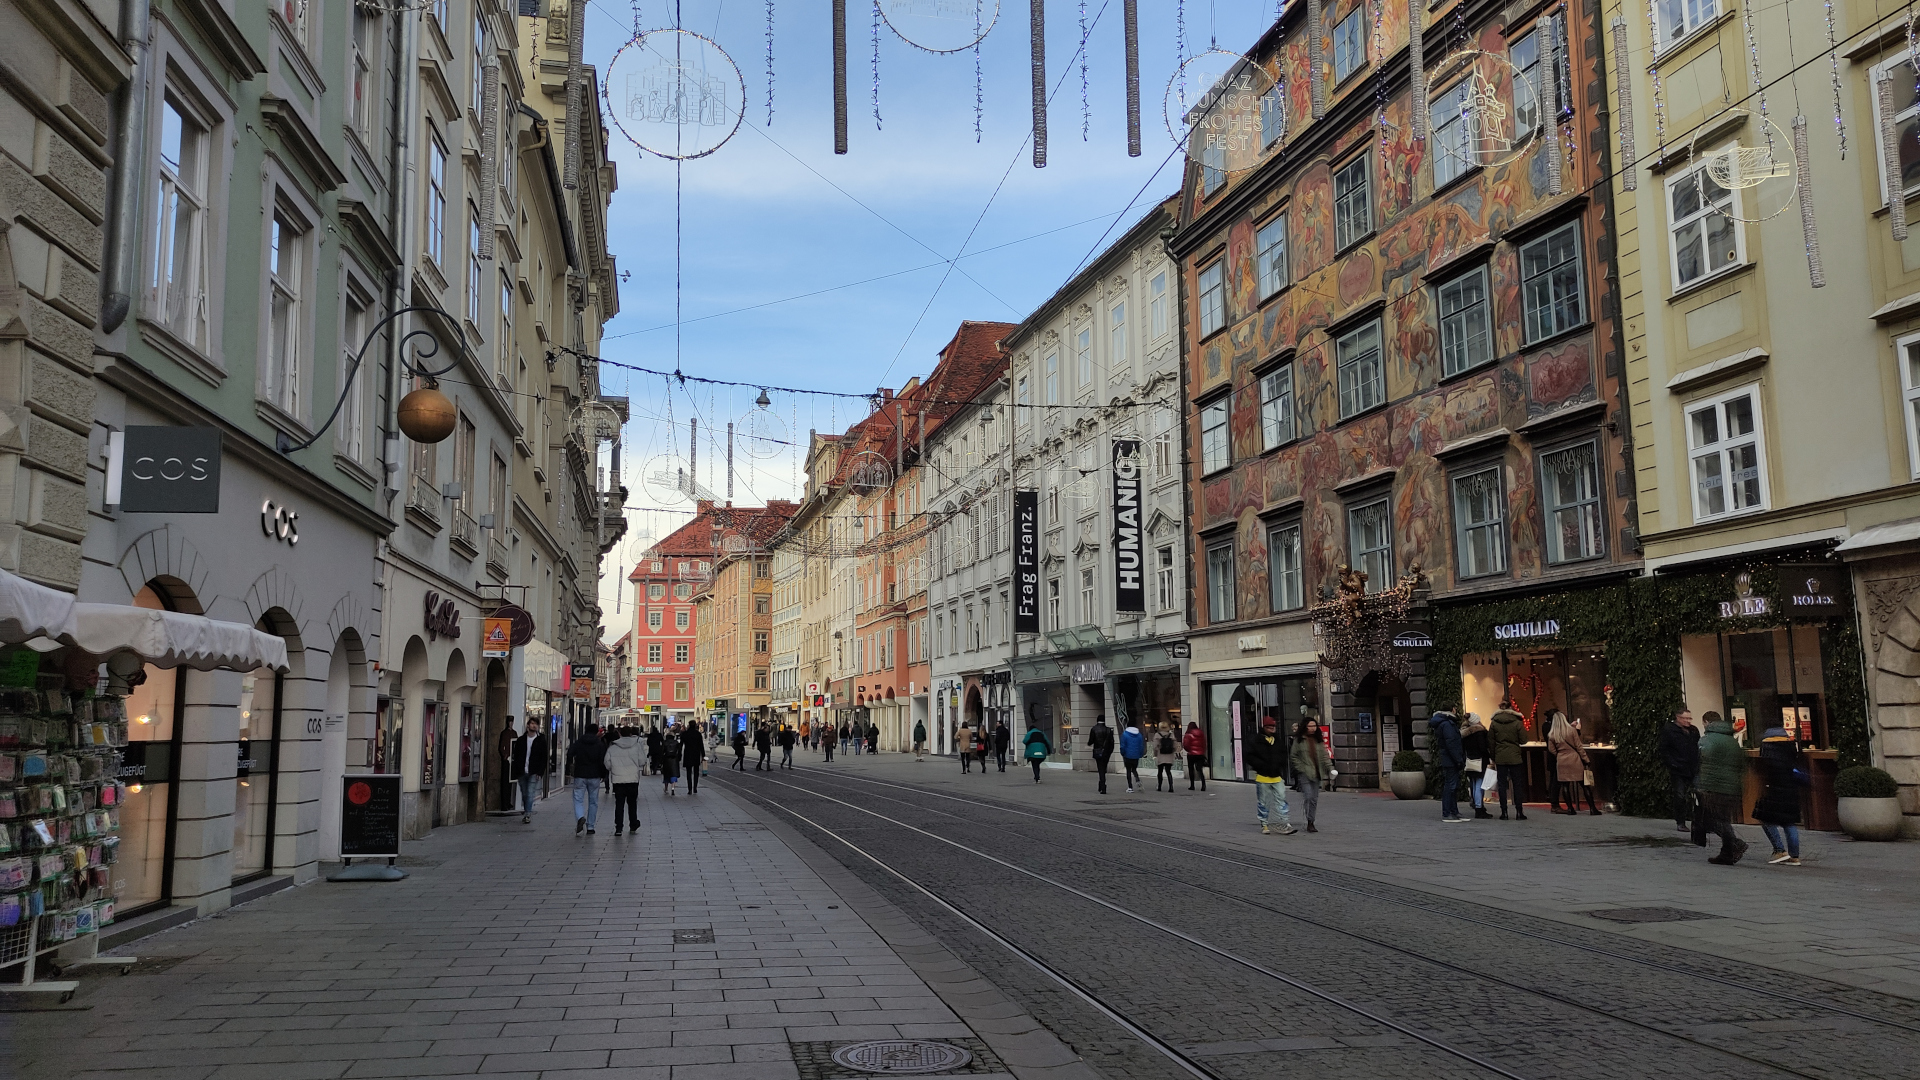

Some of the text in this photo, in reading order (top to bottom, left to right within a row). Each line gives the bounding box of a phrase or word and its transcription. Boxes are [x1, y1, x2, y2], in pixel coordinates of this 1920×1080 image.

[1198, 72, 1252, 91] GRAZ
[1188, 112, 1264, 132] FROHES
[1206, 133, 1249, 151] FEST
[131, 457, 209, 481] COS
[261, 499, 300, 547] COS
[1116, 460, 1140, 590] HUMANIC
[1018, 506, 1037, 617] Frag Franz.
[1793, 595, 1837, 606] ROLEX
[1494, 619, 1561, 640] SCHULLIN
[1238, 634, 1267, 651] ONLY
[1393, 639, 1433, 648] SCHULLIN
[307, 718, 322, 734] COS
[117, 764, 147, 777] UGEFÜGT
